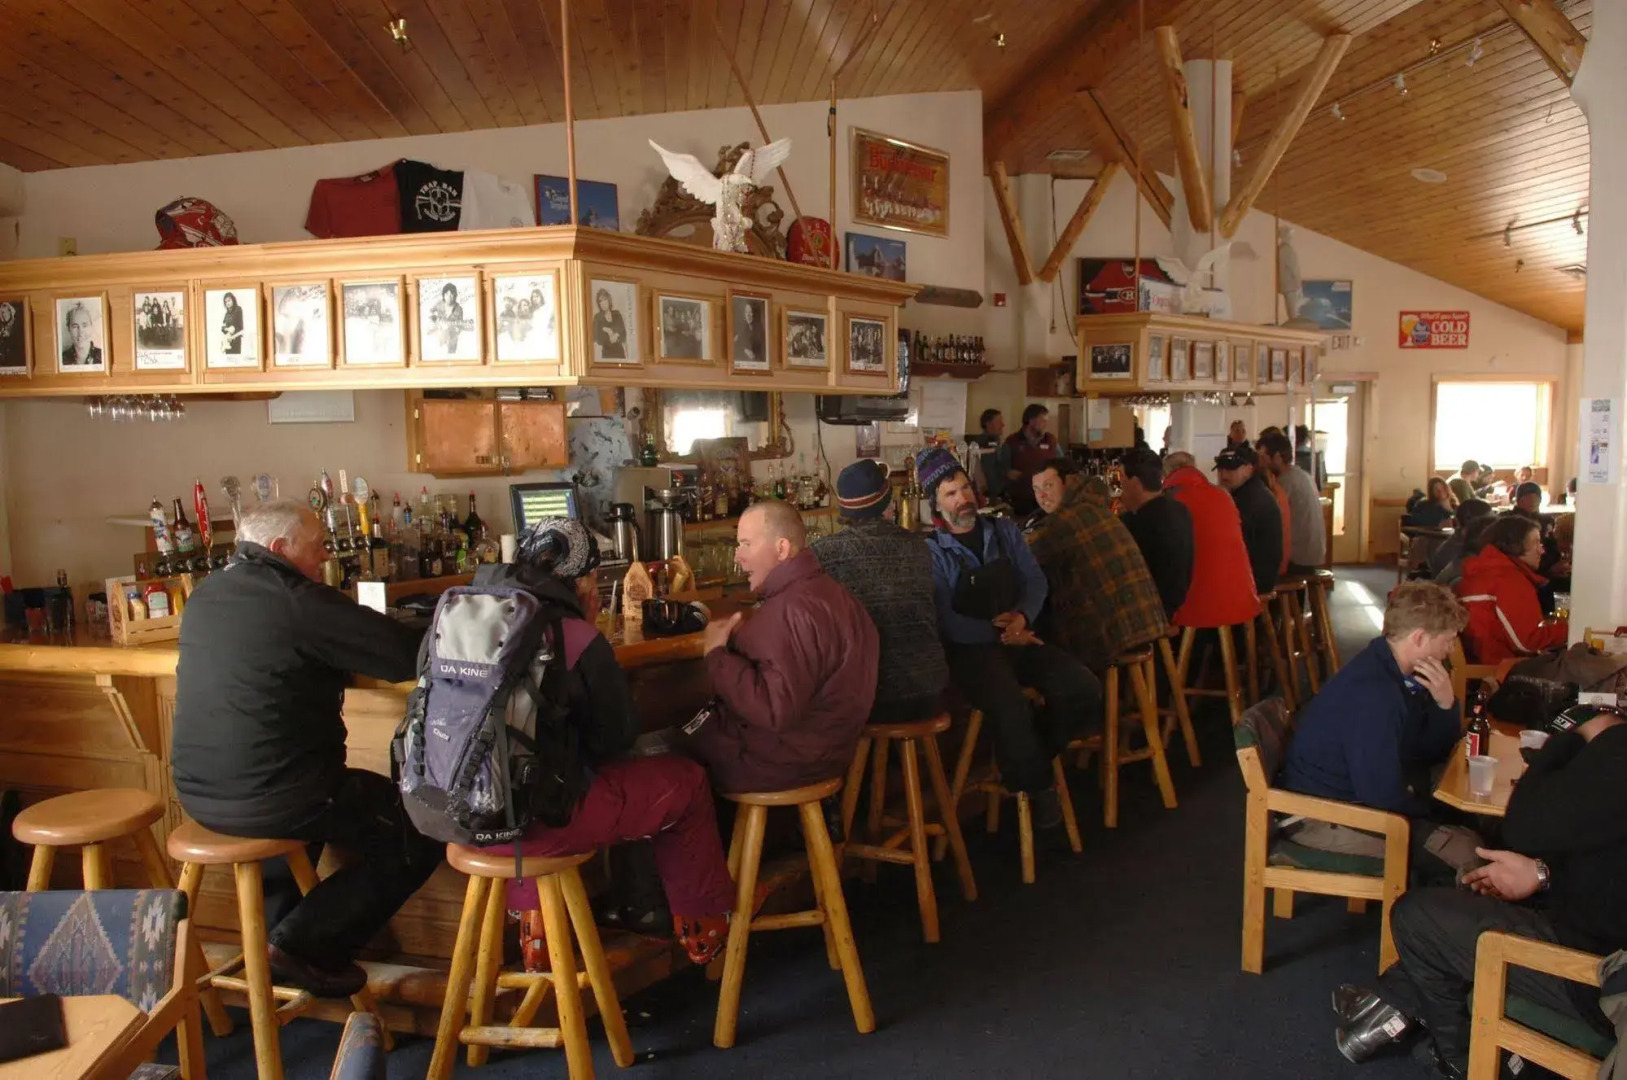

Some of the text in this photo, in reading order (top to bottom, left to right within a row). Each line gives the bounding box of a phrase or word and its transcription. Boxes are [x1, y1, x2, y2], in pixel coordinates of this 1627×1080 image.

[420, 180, 458, 197] TRAP BAR
[1431, 321, 1467, 334] COLD
[1332, 335, 1350, 350] EXIT
[1431, 333, 1467, 346] BEER
[440, 664, 488, 678] DA KINE
[495, 828, 520, 840] KINE
